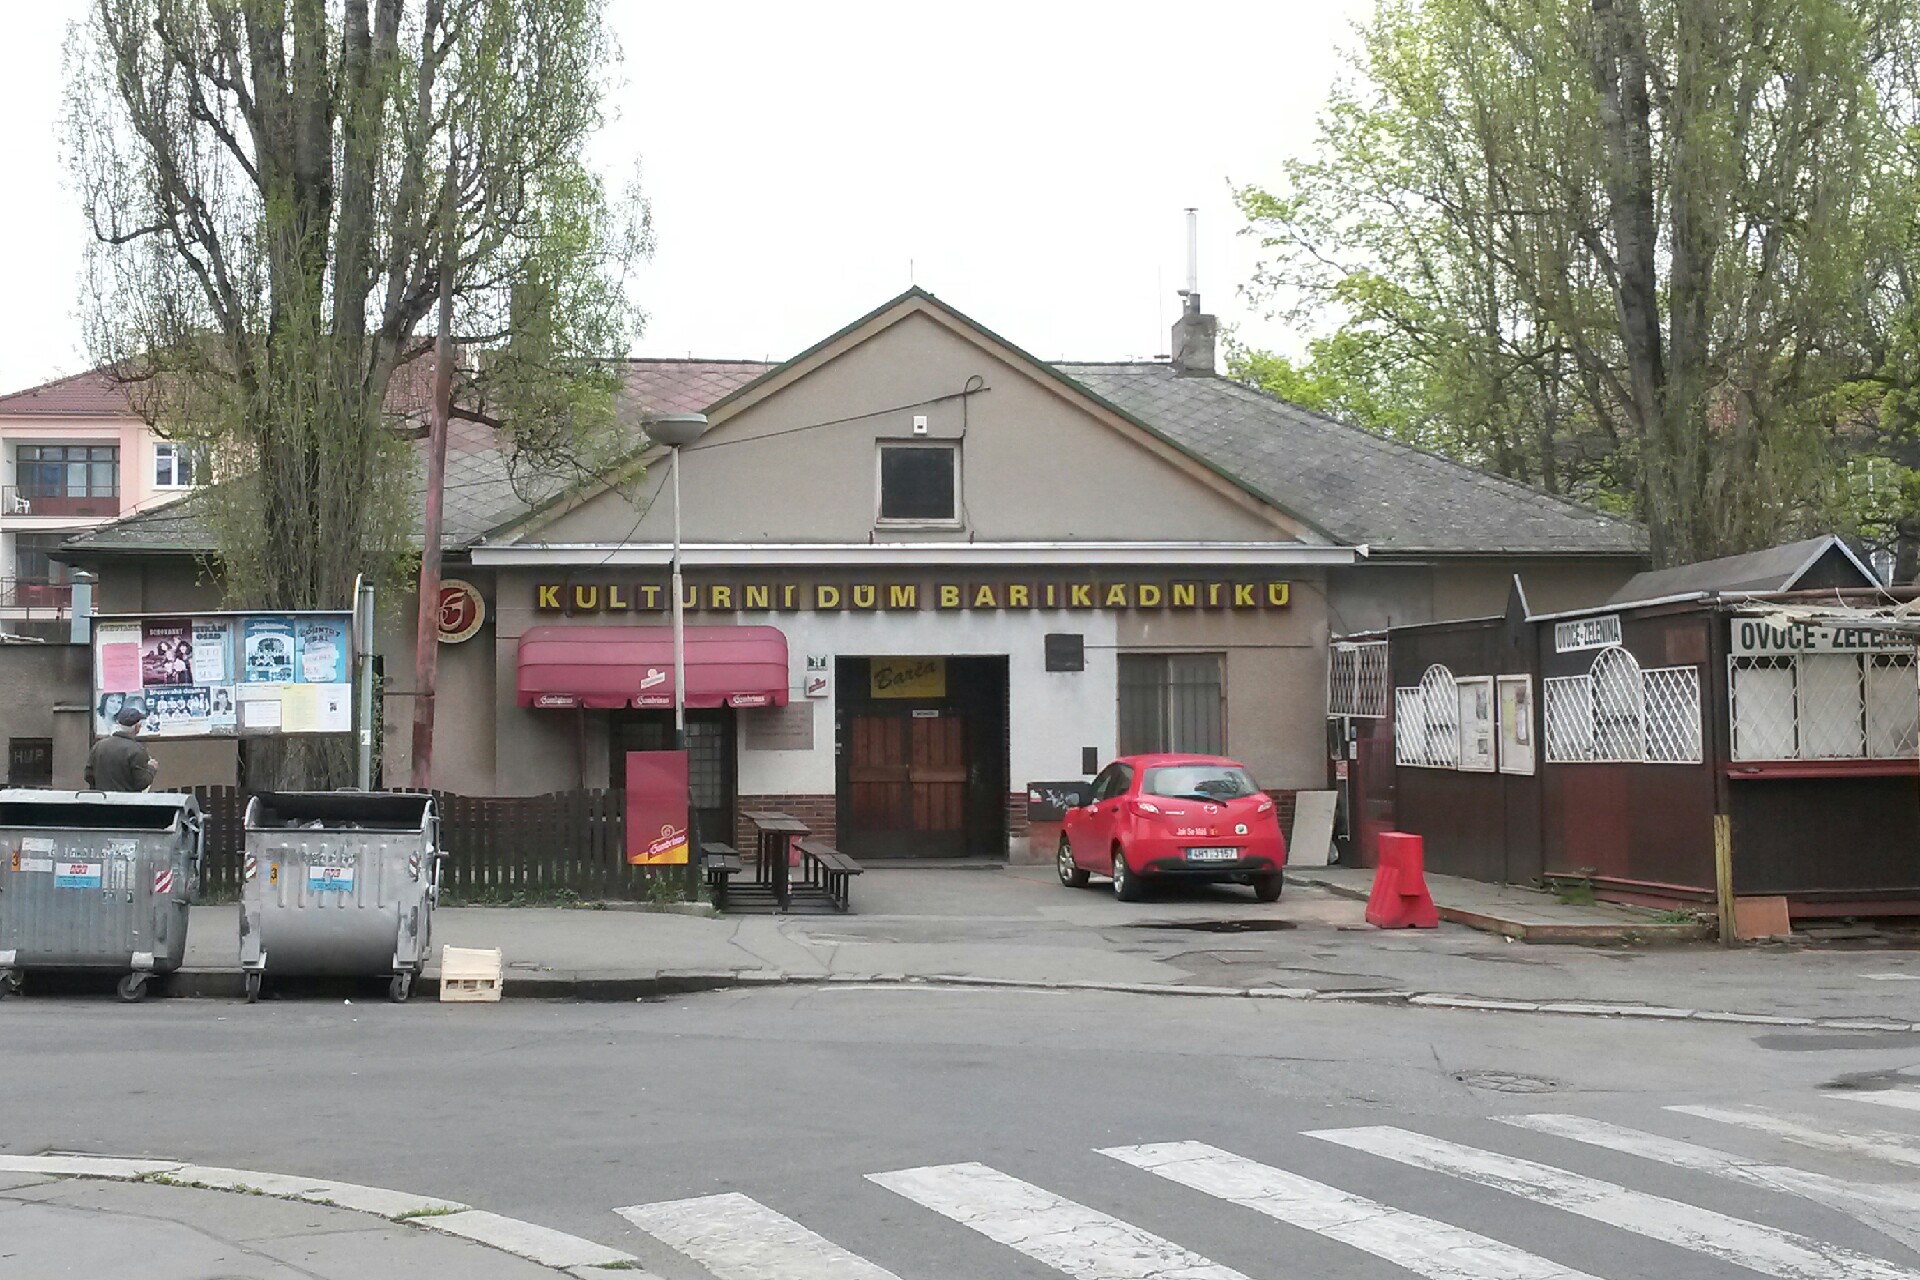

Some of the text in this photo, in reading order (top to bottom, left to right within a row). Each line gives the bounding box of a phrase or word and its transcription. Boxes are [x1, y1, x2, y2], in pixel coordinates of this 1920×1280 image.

[539, 582, 1290, 608] KULTURNÍ DŮM BARIKÁDNÍKŮ
